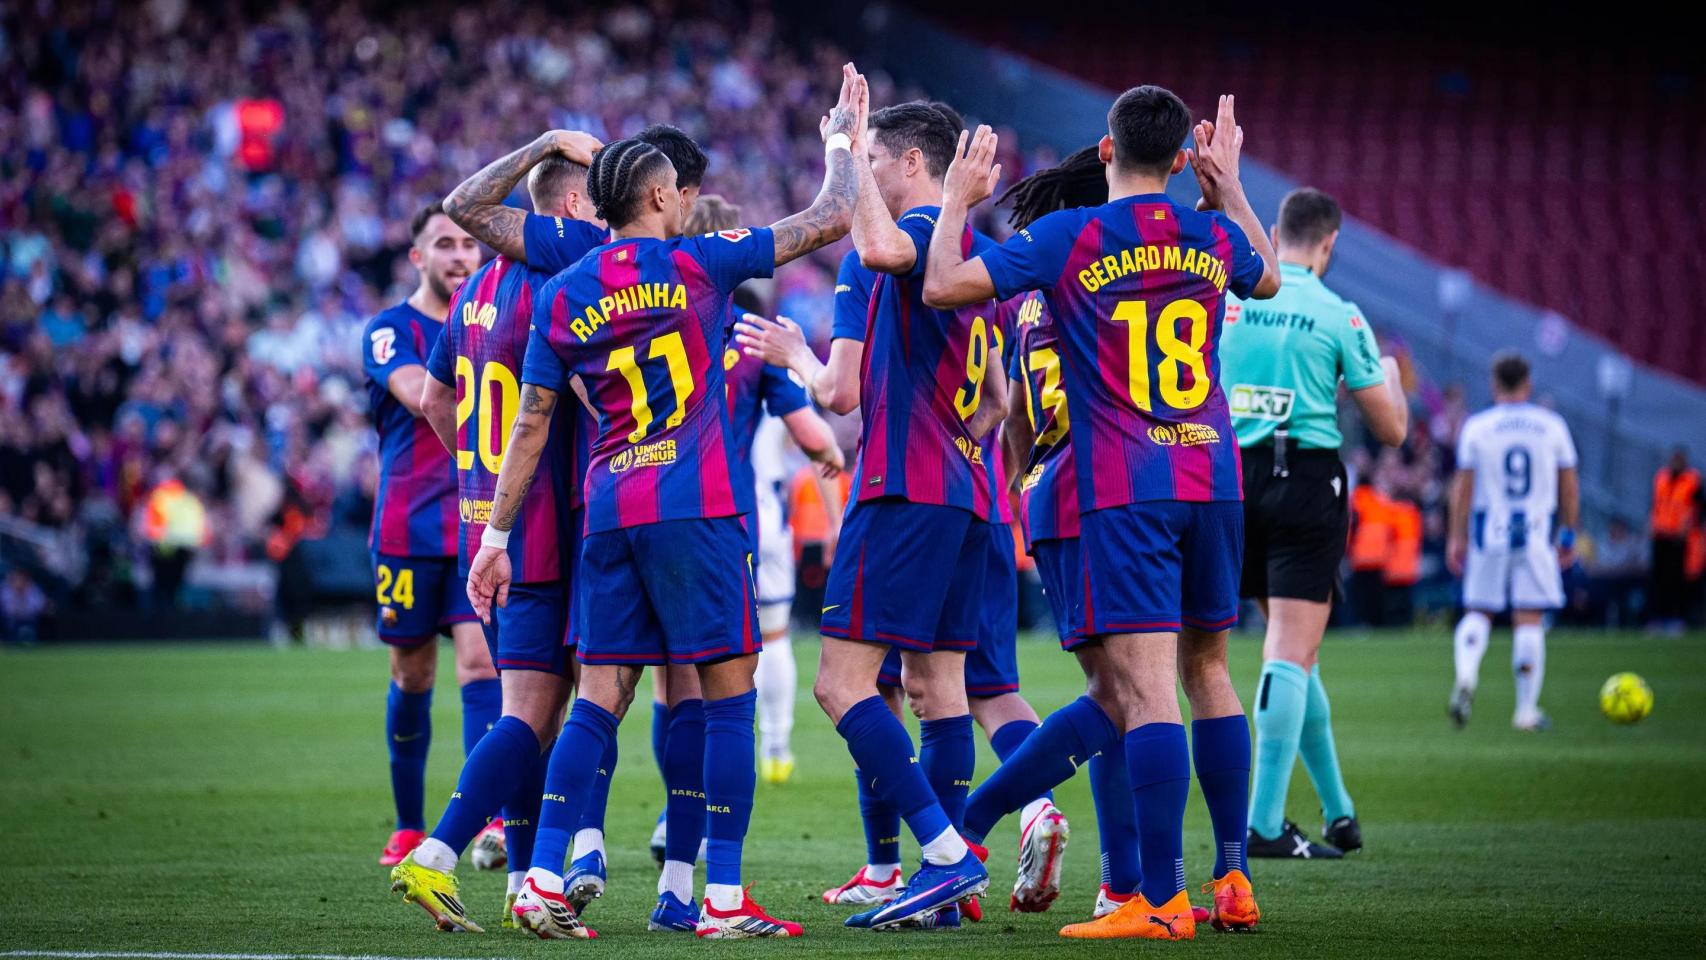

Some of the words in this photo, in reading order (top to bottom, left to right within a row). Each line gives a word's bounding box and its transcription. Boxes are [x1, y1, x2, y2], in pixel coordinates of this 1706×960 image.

[1078, 245, 1161, 293] GERARD
[569, 283, 687, 343] RAPHINHA
[954, 316, 988, 422] 9
[1110, 298, 1211, 412] 18
[605, 331, 695, 444] 11
[1233, 387, 1292, 417] BKT
[456, 356, 520, 475] 20
[1180, 430, 1220, 444] ACNUR
[634, 440, 676, 456] UNHCR
[634, 450, 677, 466] ACNUR
[1504, 445, 1531, 500] 9
[376, 564, 415, 610] 24
